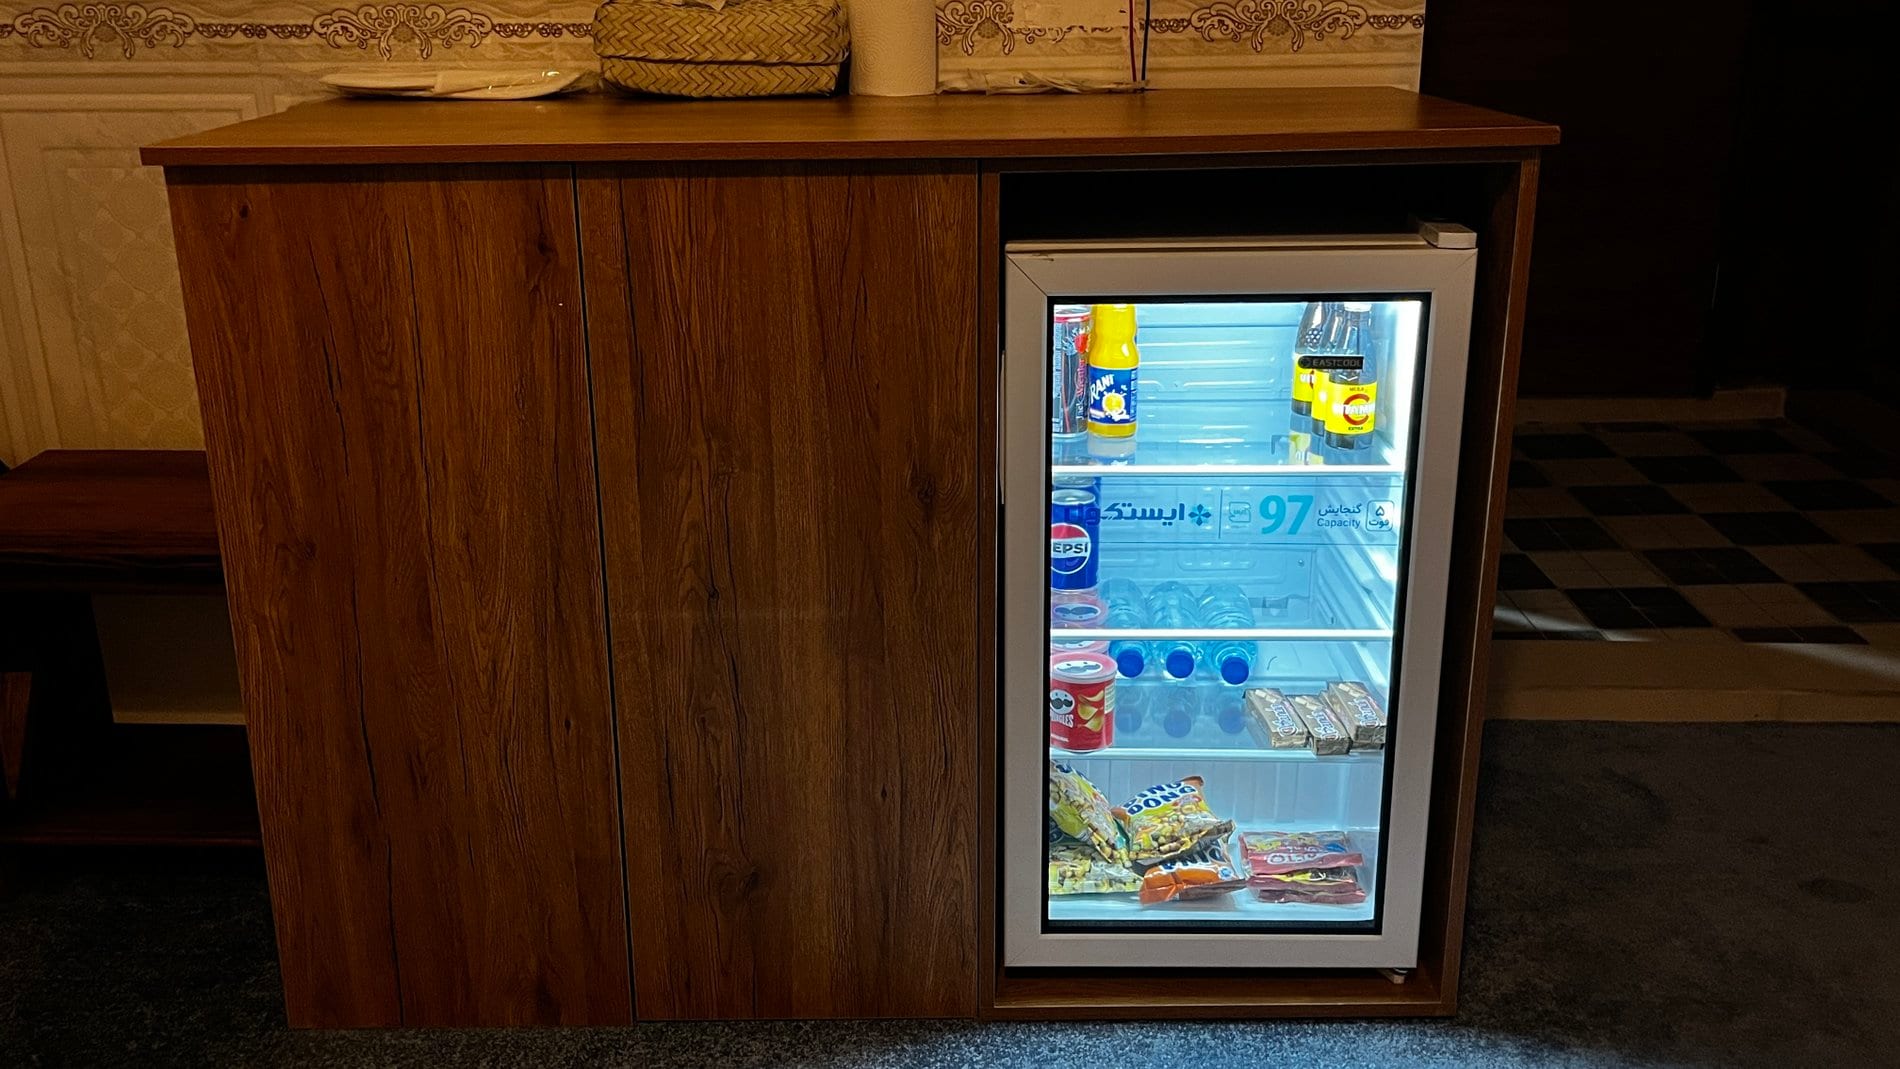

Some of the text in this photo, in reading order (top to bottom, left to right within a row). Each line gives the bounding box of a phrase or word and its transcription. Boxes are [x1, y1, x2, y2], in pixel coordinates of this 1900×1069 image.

[1312, 358, 1362, 367] EASTCOOL
[1090, 374, 1115, 404] RANI
[1259, 494, 1314, 535] 97
[1318, 502, 1362, 516] گنجایش
[1317, 518, 1361, 529] Capacity
[1052, 542, 1088, 554] EPSI
[1127, 785, 1197, 815] DONG
